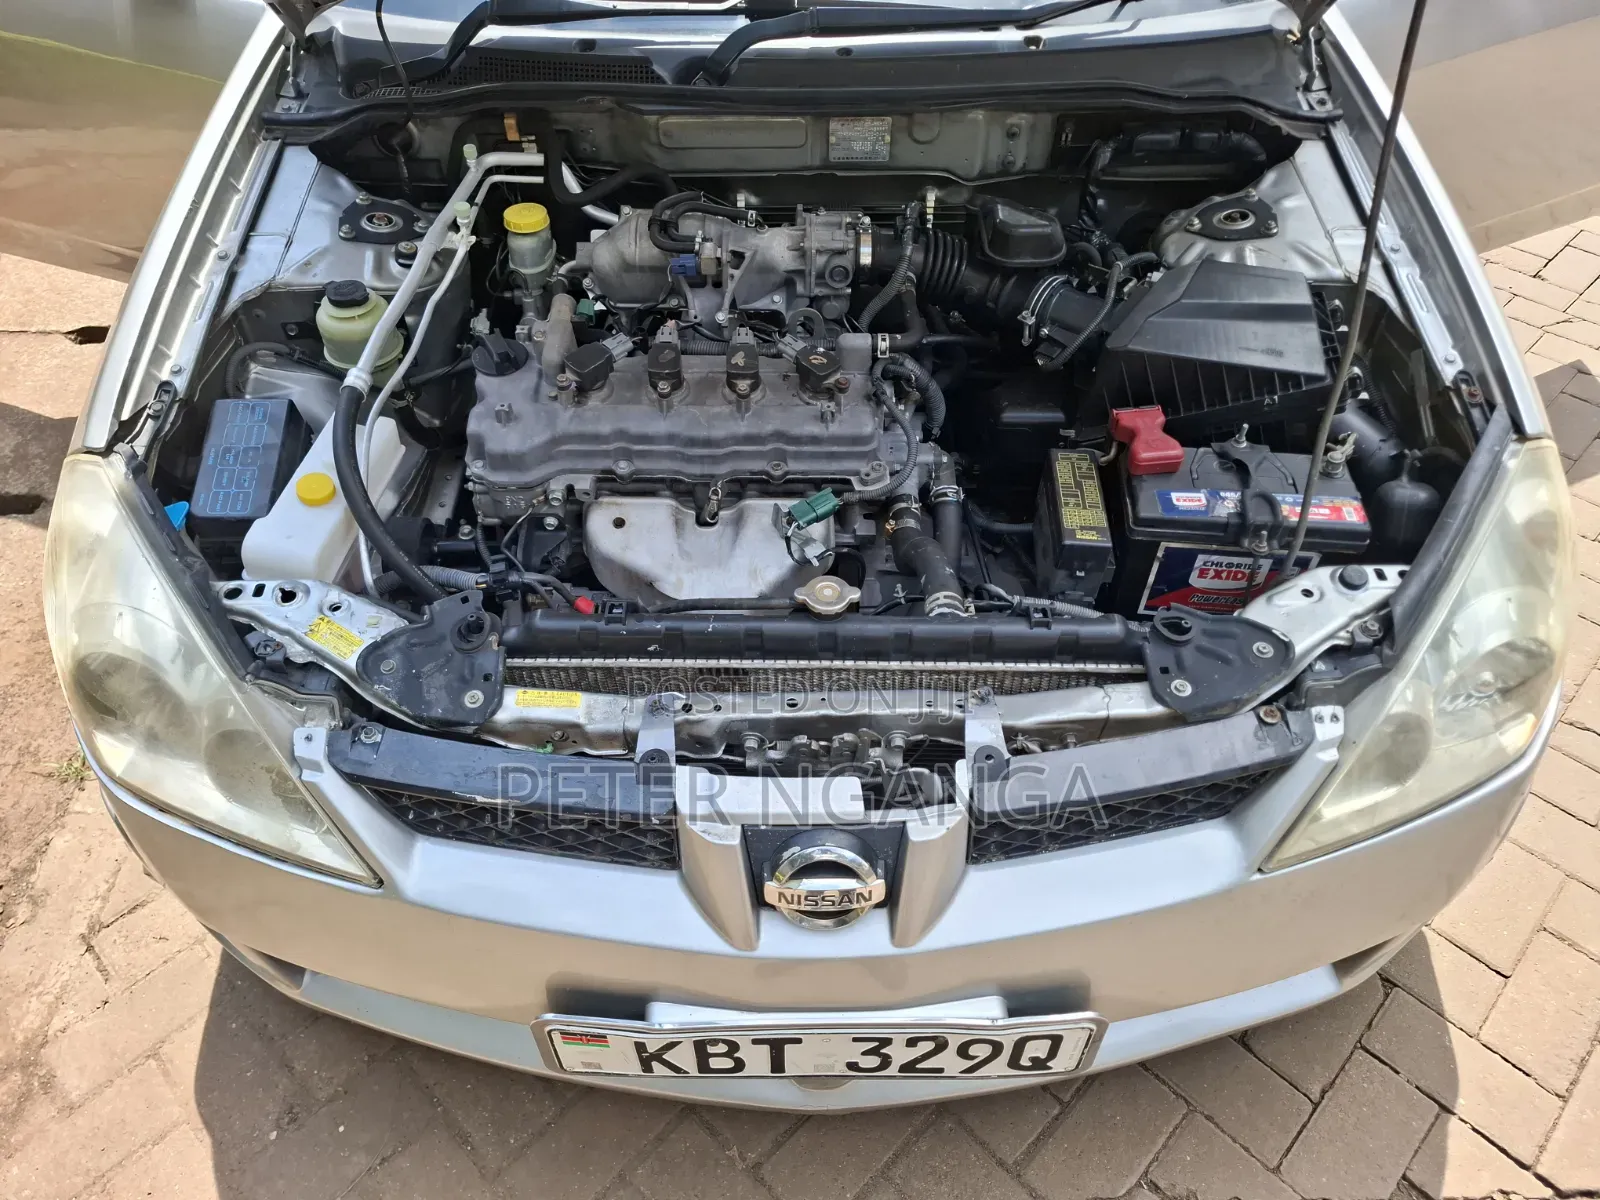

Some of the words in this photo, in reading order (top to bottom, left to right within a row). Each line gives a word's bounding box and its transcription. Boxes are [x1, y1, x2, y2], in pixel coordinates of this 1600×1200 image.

[777, 889, 873, 907] NISSAN
[633, 1036, 803, 1075] KBT
[845, 1033, 1064, 1075] 329Q
